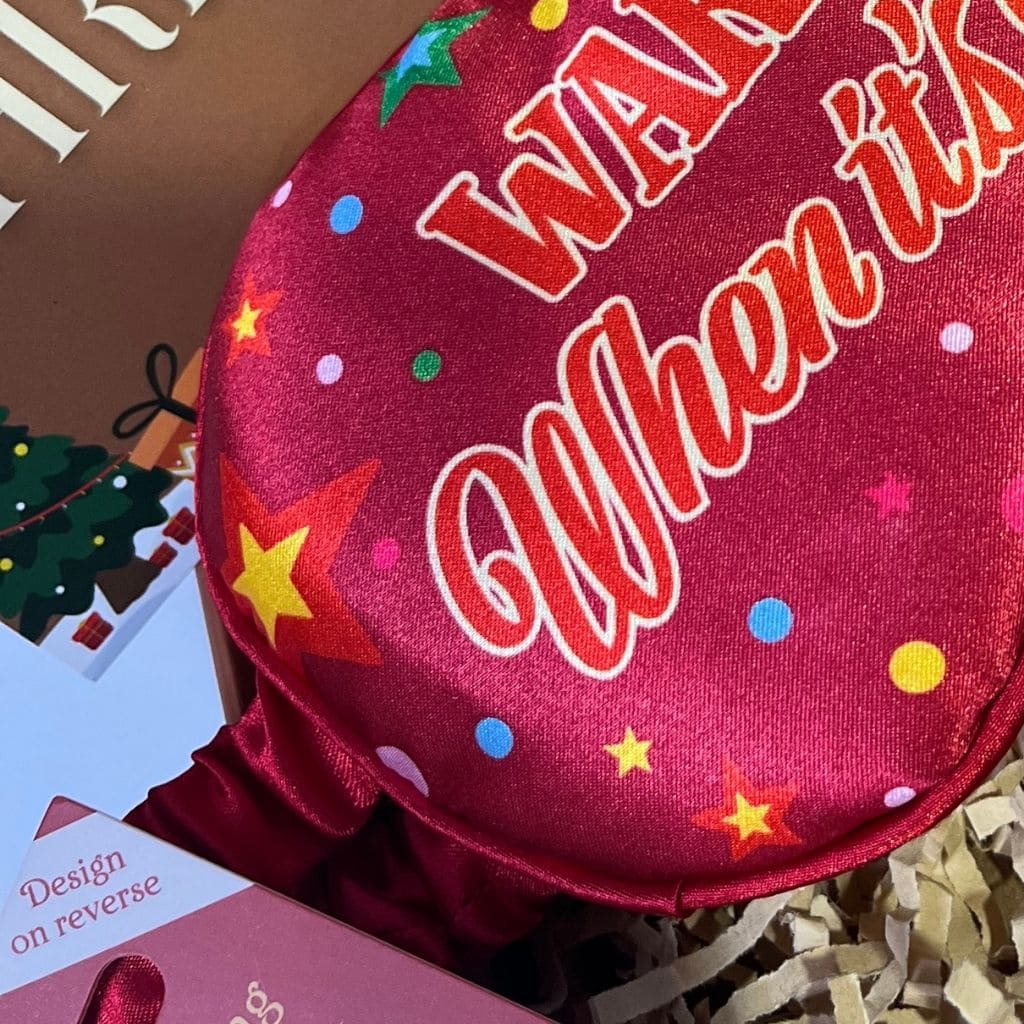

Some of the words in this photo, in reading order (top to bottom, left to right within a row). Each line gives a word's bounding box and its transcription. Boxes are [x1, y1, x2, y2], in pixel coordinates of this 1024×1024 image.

[426, 196, 884, 680] When
[11, 926, 49, 955] on
[54, 875, 163, 938] reverse
[19, 849, 126, 908] Design
